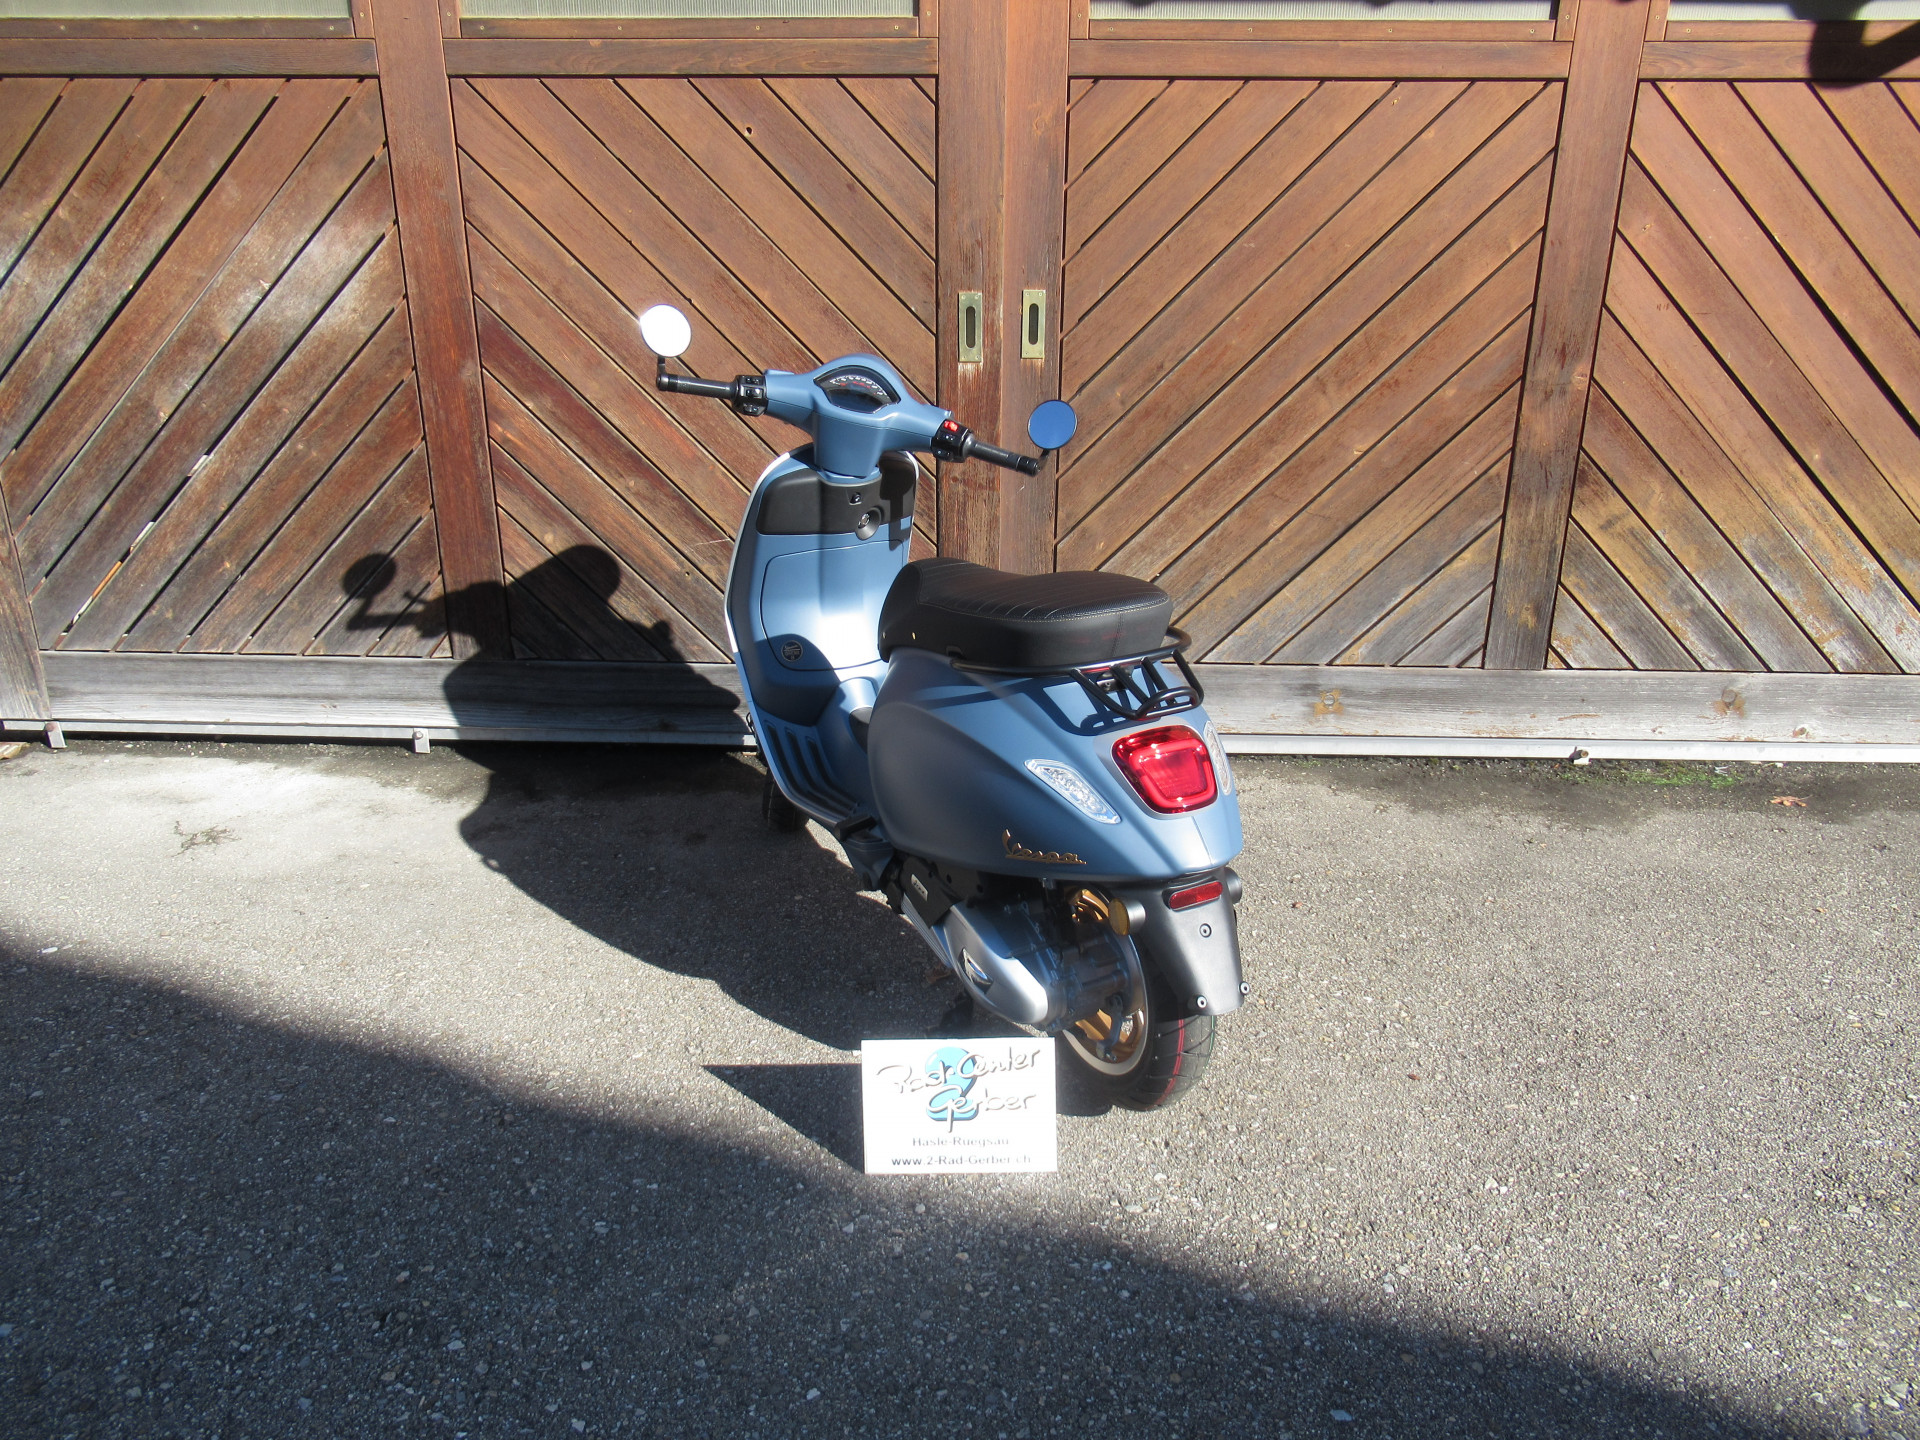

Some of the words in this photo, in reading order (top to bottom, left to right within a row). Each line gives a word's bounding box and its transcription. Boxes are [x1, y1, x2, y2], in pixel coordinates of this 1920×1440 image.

[1002, 829, 1087, 864] Vespa
[956, 1047, 1041, 1079] Center
[928, 1084, 1037, 1133] Gerber
[891, 1154, 1031, 1166] www.2-Rad-Gerber.ch
